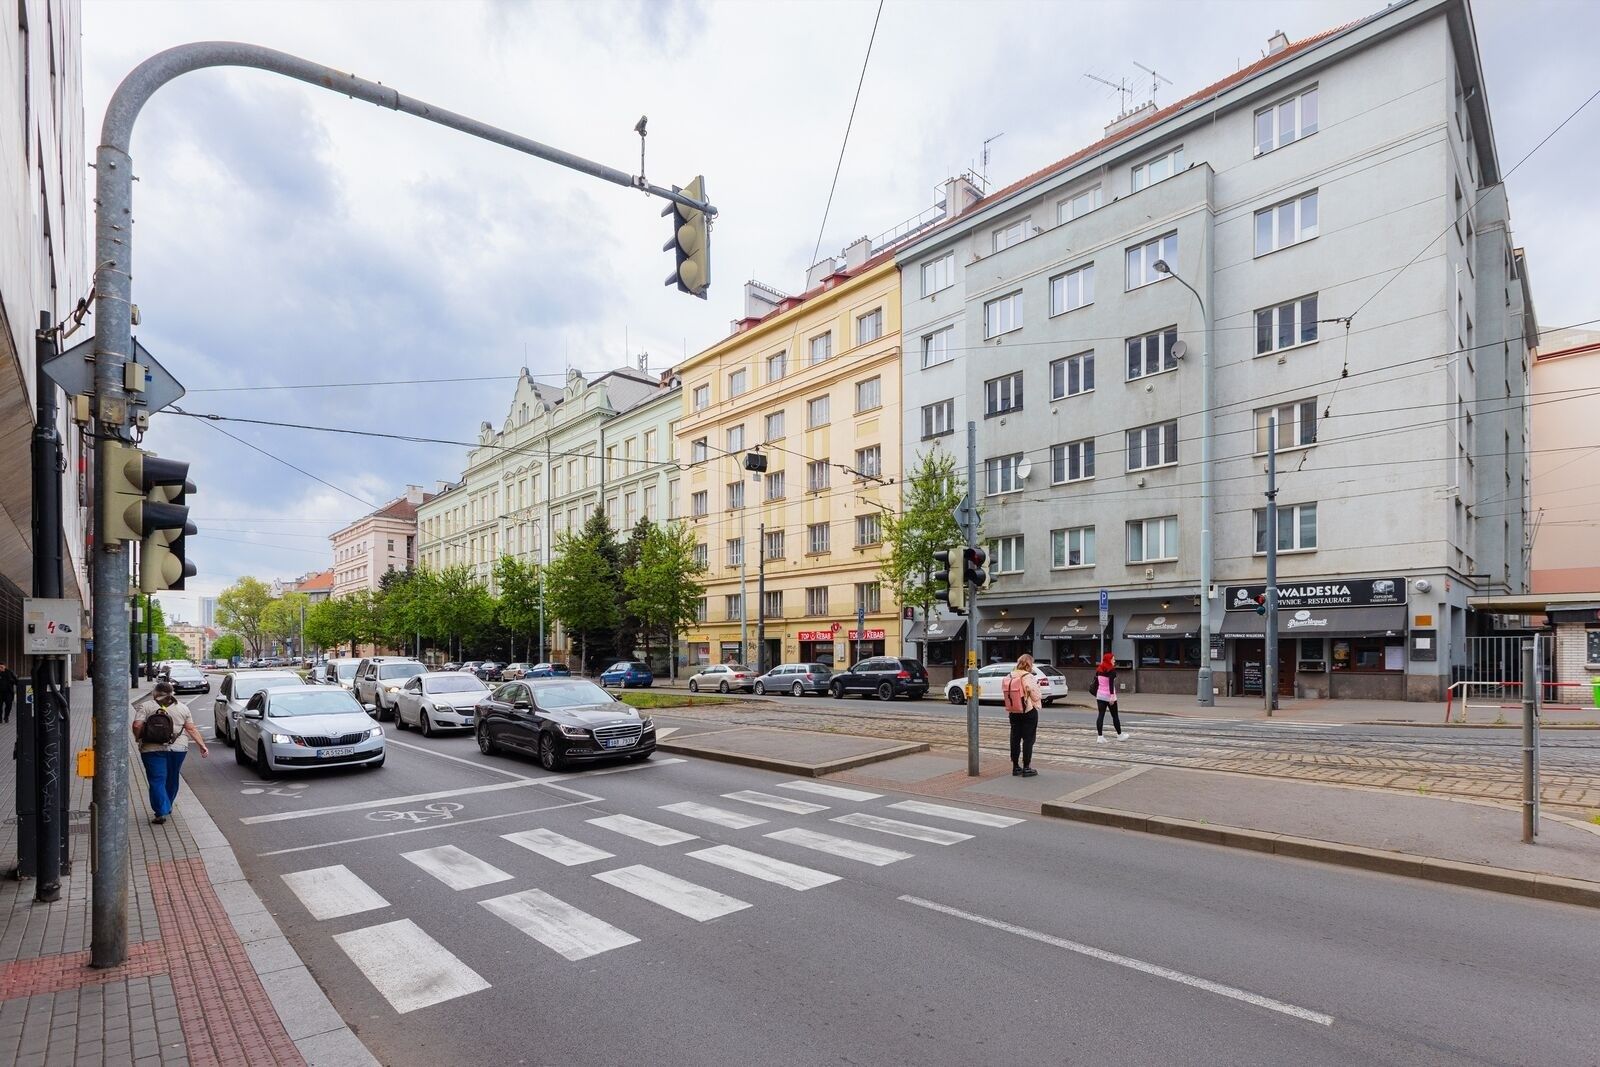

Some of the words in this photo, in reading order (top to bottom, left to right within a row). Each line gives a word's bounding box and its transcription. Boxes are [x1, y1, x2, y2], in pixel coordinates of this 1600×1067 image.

[1277, 585, 1351, 598] WALDESKA
[1308, 597, 1352, 605] RESTAURACE
[867, 631, 884, 639] KEBAB
